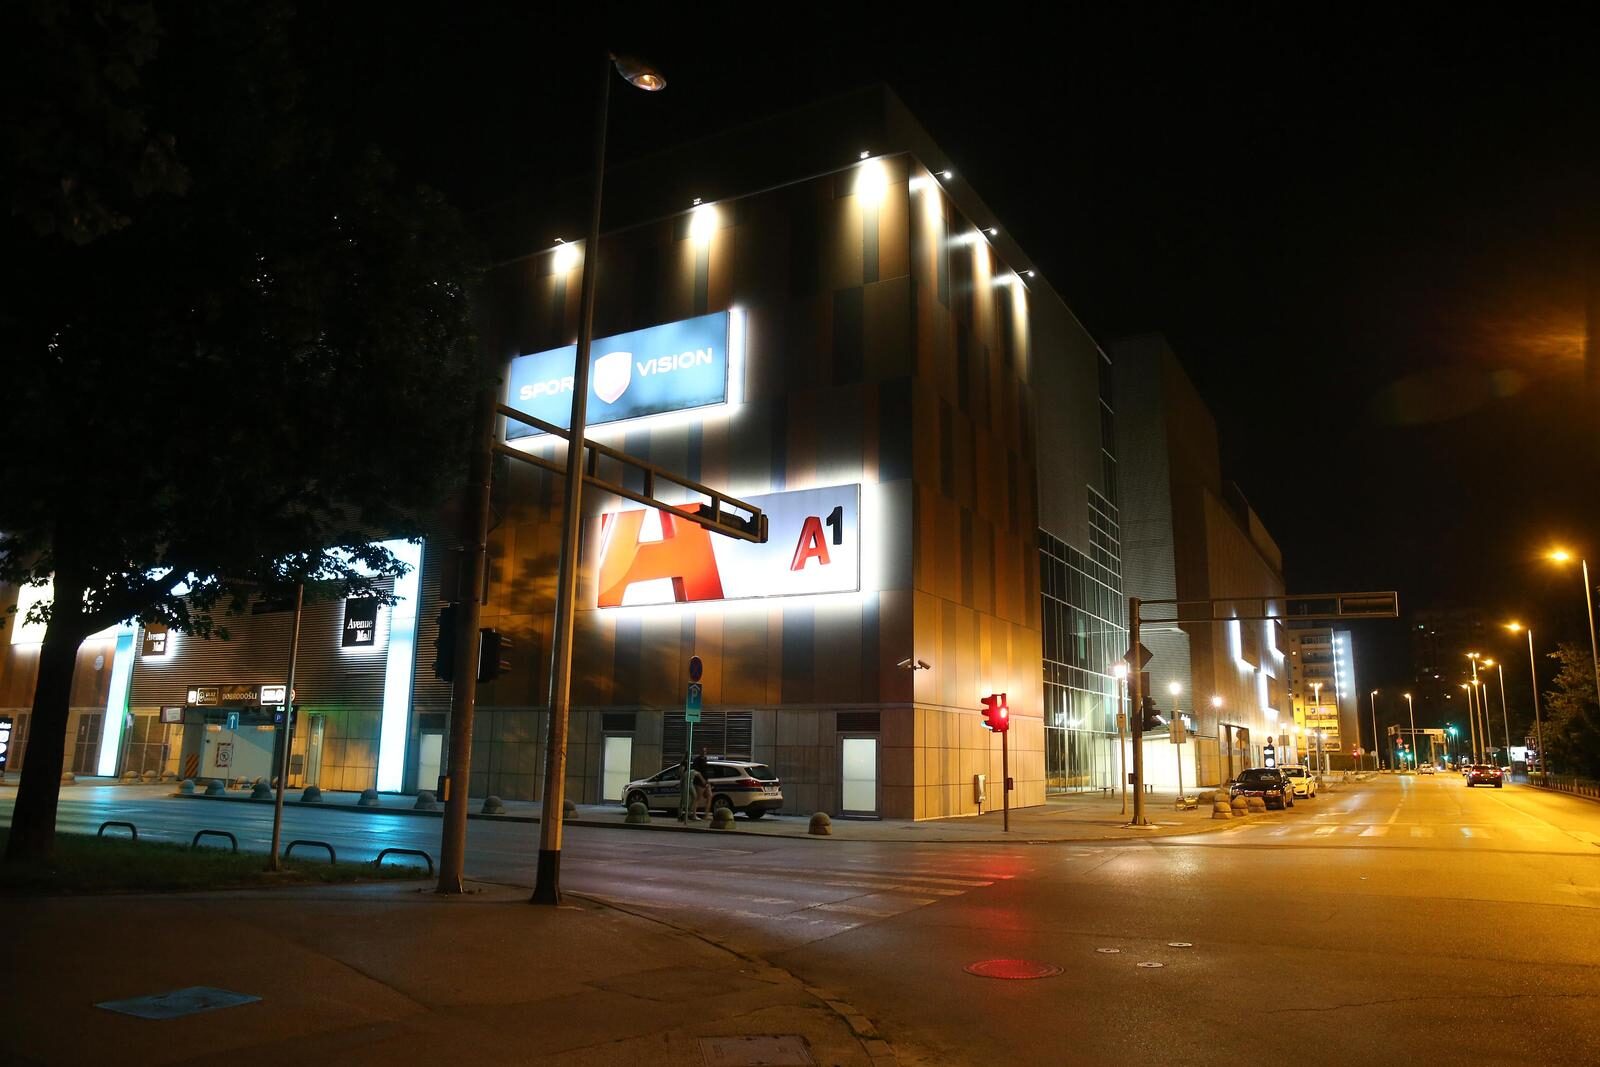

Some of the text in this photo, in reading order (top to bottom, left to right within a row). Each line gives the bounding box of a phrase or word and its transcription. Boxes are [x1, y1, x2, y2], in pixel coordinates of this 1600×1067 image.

[519, 347, 713, 401] SPOR VISION
[789, 505, 844, 572] A1
[346, 617, 373, 630] Avenue
[355, 629, 372, 642] Mall
